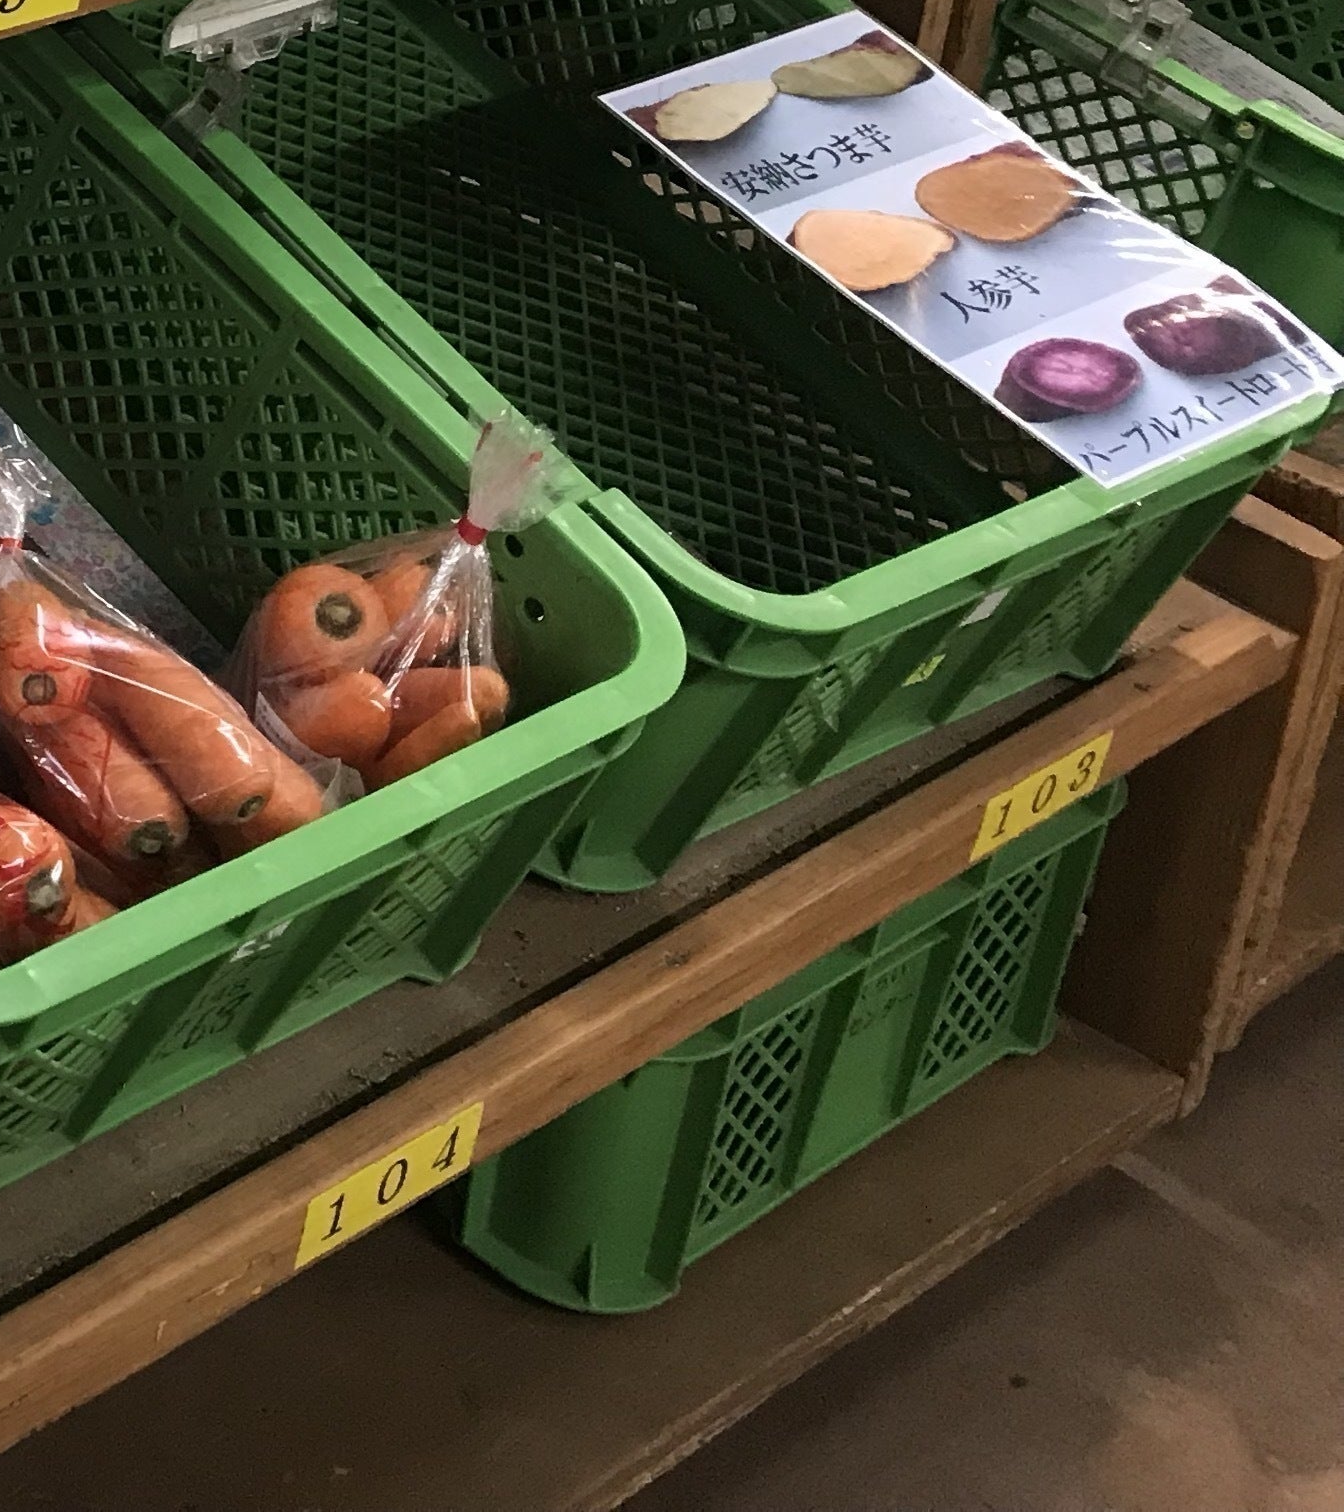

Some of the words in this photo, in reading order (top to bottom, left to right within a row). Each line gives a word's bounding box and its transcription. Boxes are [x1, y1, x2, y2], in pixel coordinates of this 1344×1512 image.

[720, 123, 893, 202] 安納さつま芋
[939, 265, 1041, 324] 人参芋
[990, 749, 1098, 843] 103
[319, 1124, 463, 1242] 104
